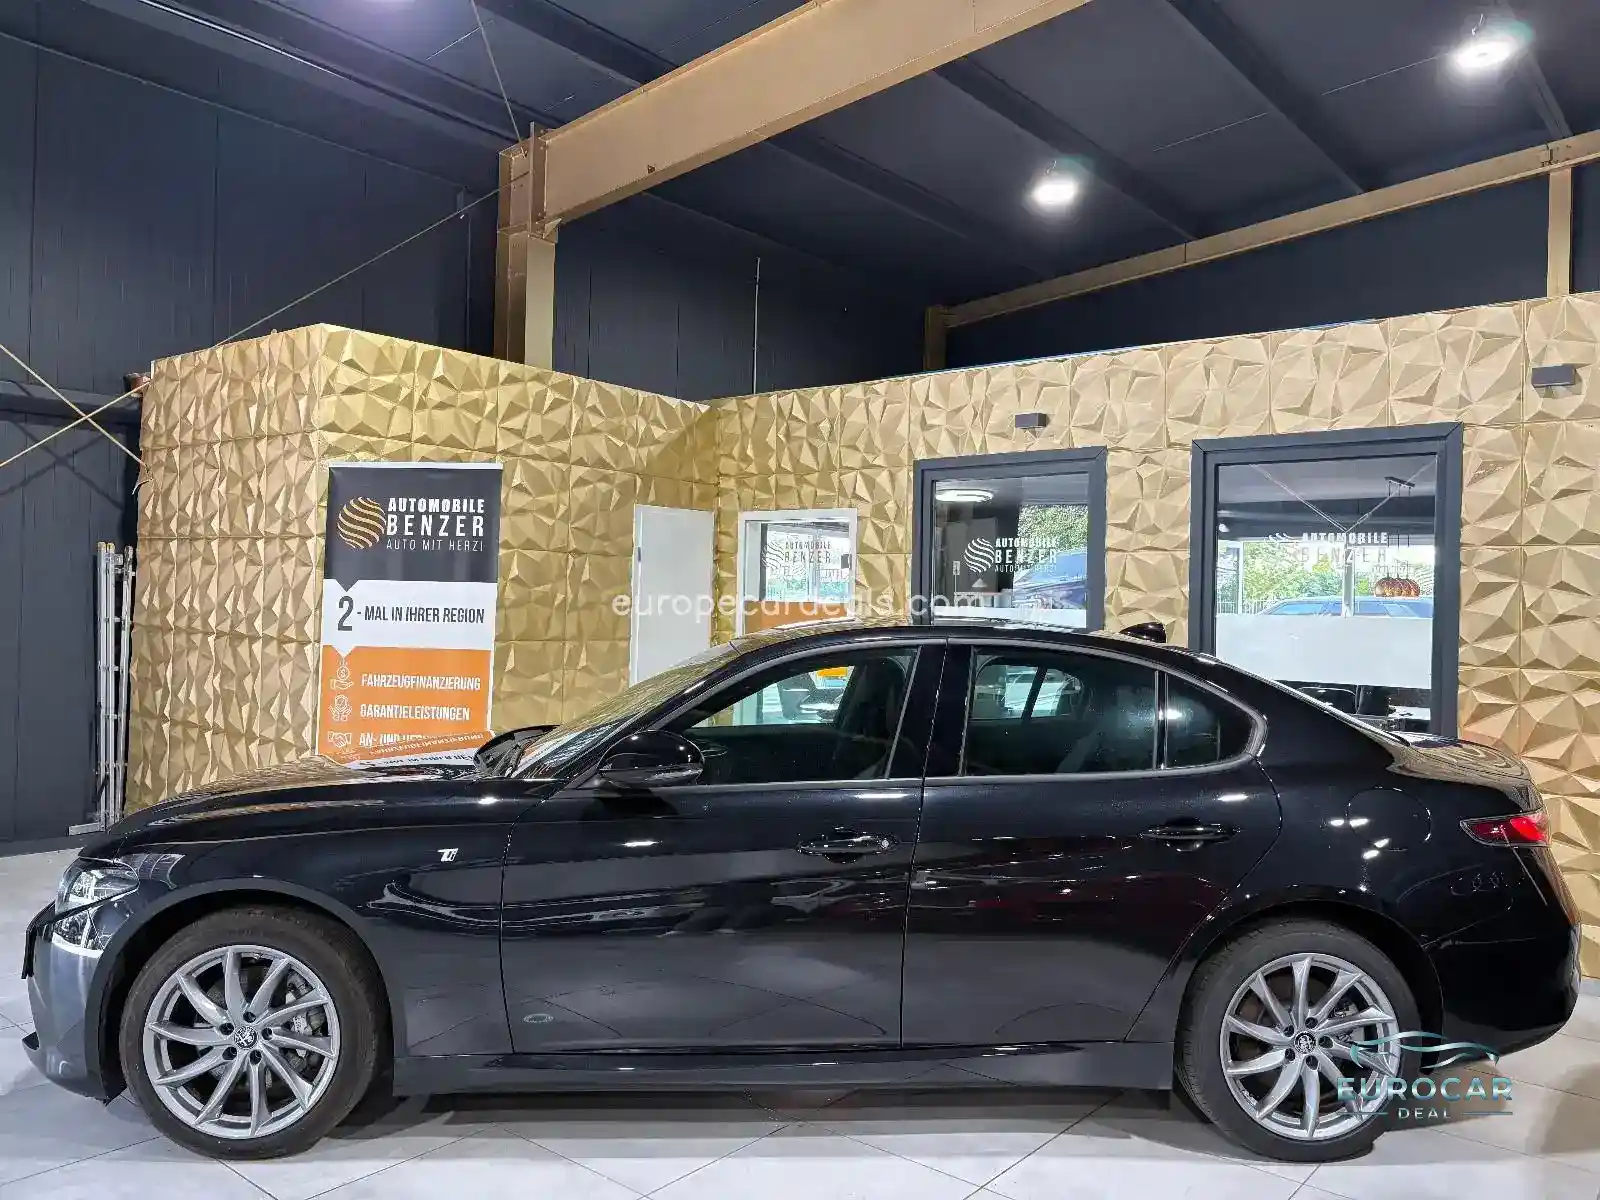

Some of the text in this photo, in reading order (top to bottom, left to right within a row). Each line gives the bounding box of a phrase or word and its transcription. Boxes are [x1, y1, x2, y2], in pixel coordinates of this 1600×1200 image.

[387, 497, 485, 513] AUTOMOBILE
[386, 514, 485, 537] BENZER
[386, 539, 416, 550] AUTO
[422, 539, 443, 551] MIT
[785, 541, 832, 550] AUTOMOBILE
[1302, 532, 1389, 544] AUTOMOBILE
[784, 551, 832, 564] BENZER
[994, 549, 1057, 564] BENZER
[1301, 546, 1387, 564] BENZER
[337, 595, 354, 632] 2
[391, 606, 403, 621] IN
[405, 606, 440, 623] IHRER
[442, 607, 485, 624] REGION
[361, 673, 481, 691] FAHRZEUGFINANZIERUNG
[359, 703, 470, 721] GARANTIELEISTUNGEN
